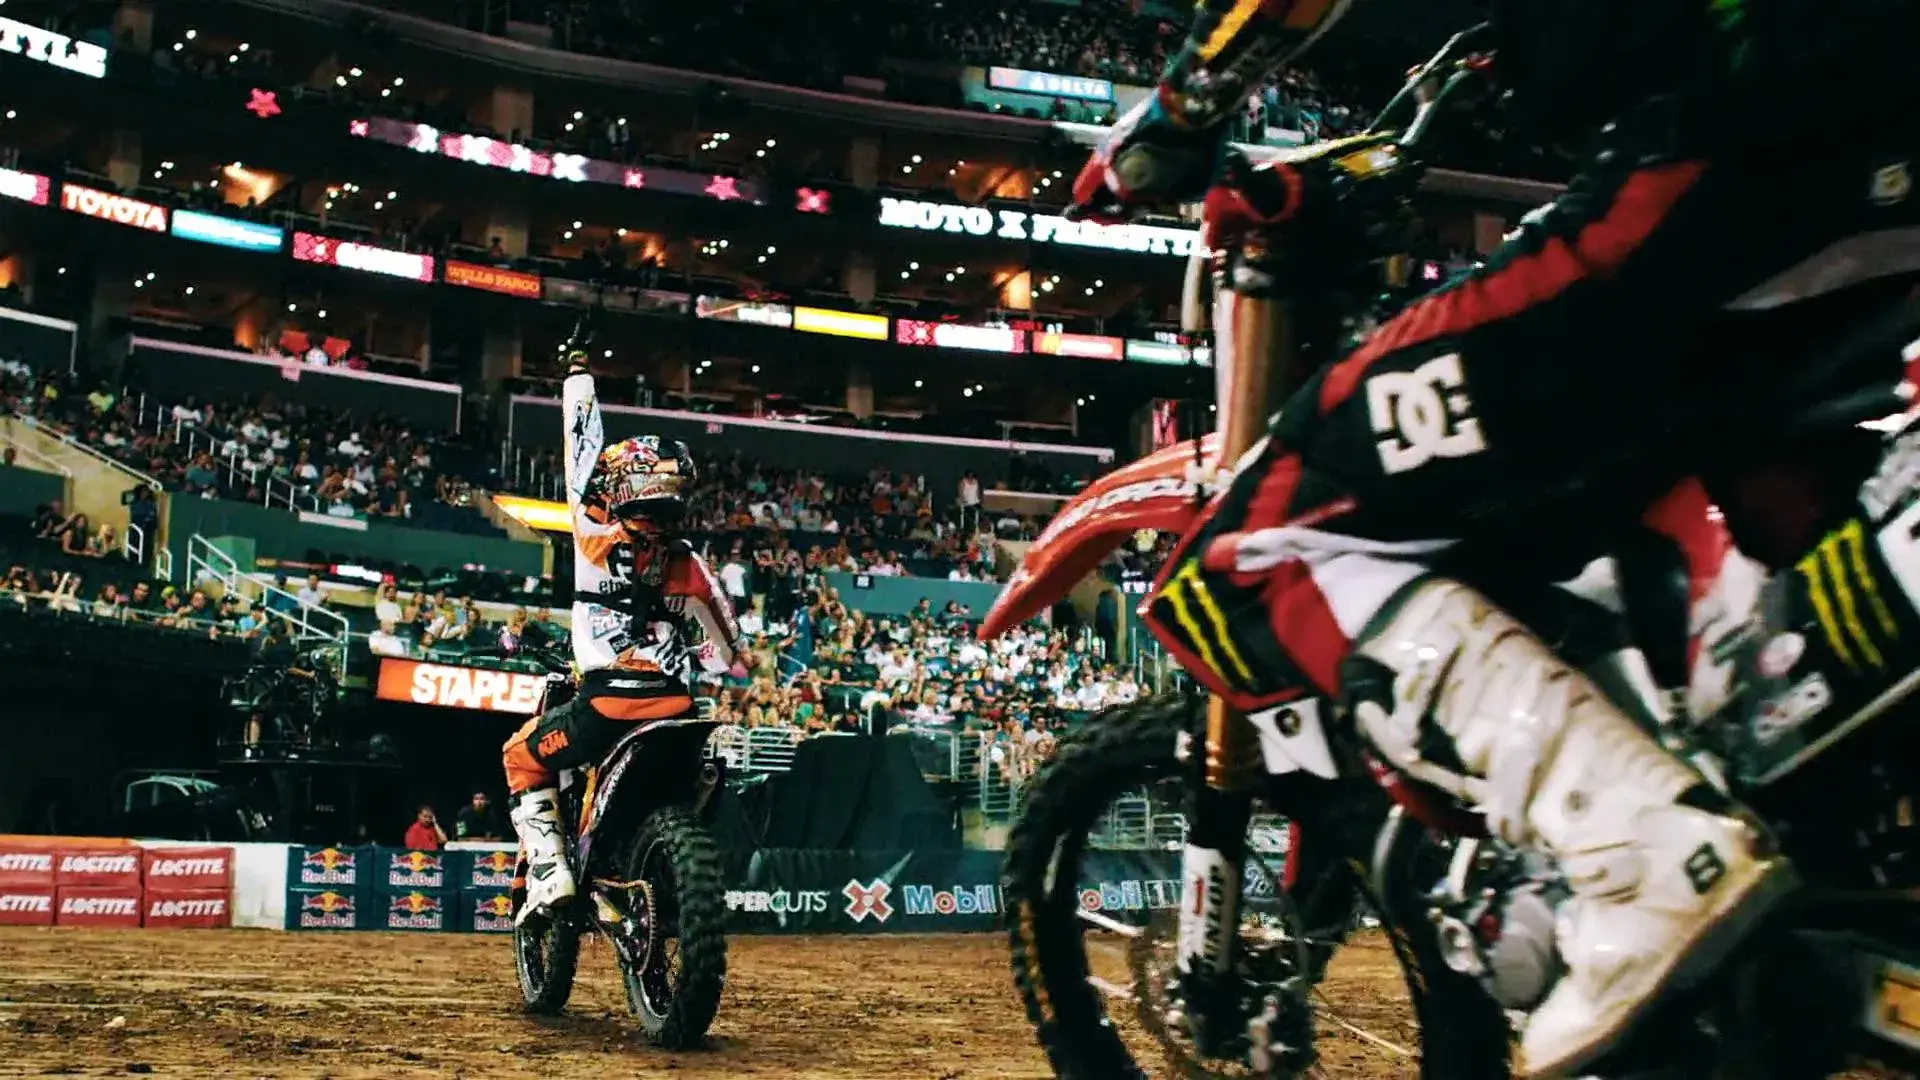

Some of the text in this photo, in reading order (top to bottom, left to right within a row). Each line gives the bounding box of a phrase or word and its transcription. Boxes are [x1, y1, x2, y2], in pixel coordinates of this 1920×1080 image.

[62, 184, 167, 232] TOYOTA
[879, 197, 994, 236] MOTO
[997, 210, 1028, 240] X
[449, 266, 495, 285] WELLS
[496, 272, 540, 293] FARGO
[61, 856, 136, 873] LOCTITE
[150, 858, 224, 876] LOCTITE
[302, 868, 356, 885] Red Bull
[389, 870, 442, 887] Red Bull
[473, 871, 499, 886] Red
[903, 885, 997, 914] Mobil
[1078, 880, 1142, 911] obil
[61, 898, 136, 914] LOCTITE
[150, 900, 224, 917] LOCTITE
[301, 911, 356, 928] Red Bull
[389, 912, 442, 929] Red Bull
[475, 915, 500, 930] Red
